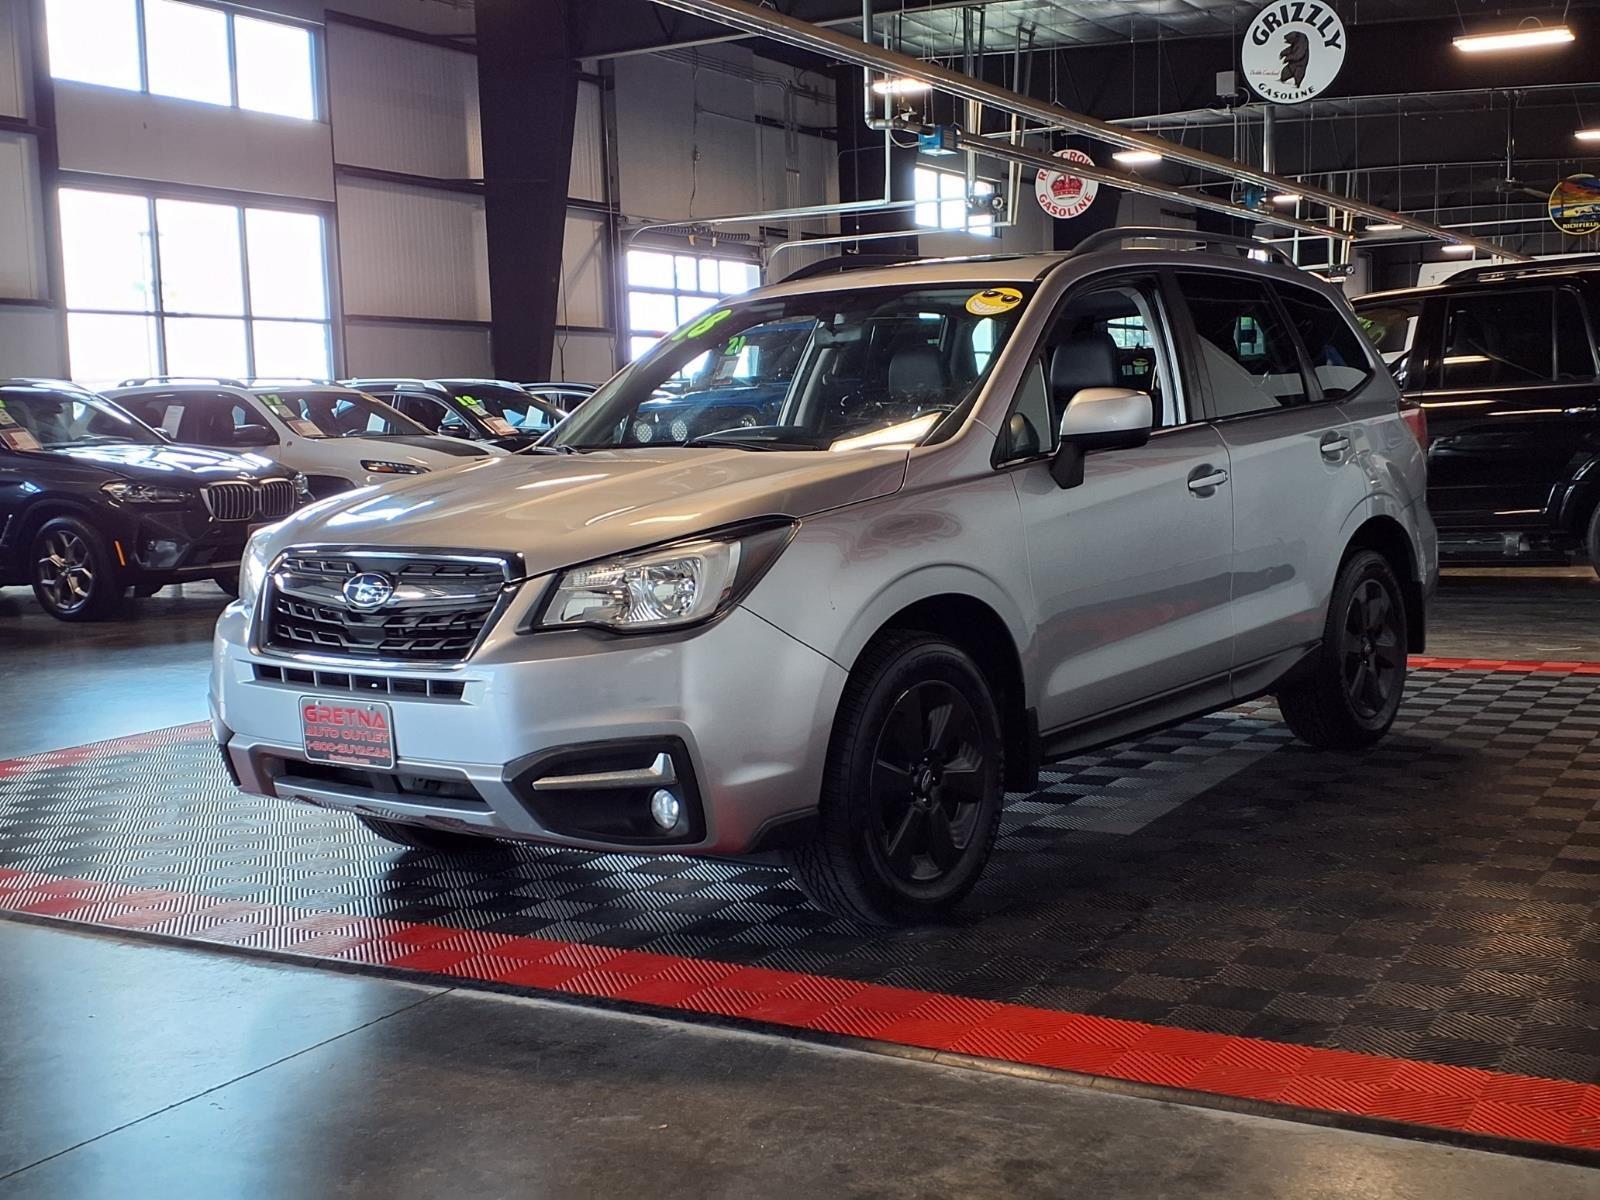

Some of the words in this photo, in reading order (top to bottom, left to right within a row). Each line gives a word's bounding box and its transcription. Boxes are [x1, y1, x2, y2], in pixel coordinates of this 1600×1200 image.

[1252, 2, 1342, 50] GRIZZLY
[1258, 82, 1316, 100] GASOLINE
[1060, 151, 1090, 165] CRO
[1039, 192, 1094, 217] GASOLINE
[304, 705, 387, 729] GRETNA
[306, 726, 339, 738] AUTO
[342, 729, 389, 742] OUTLET
